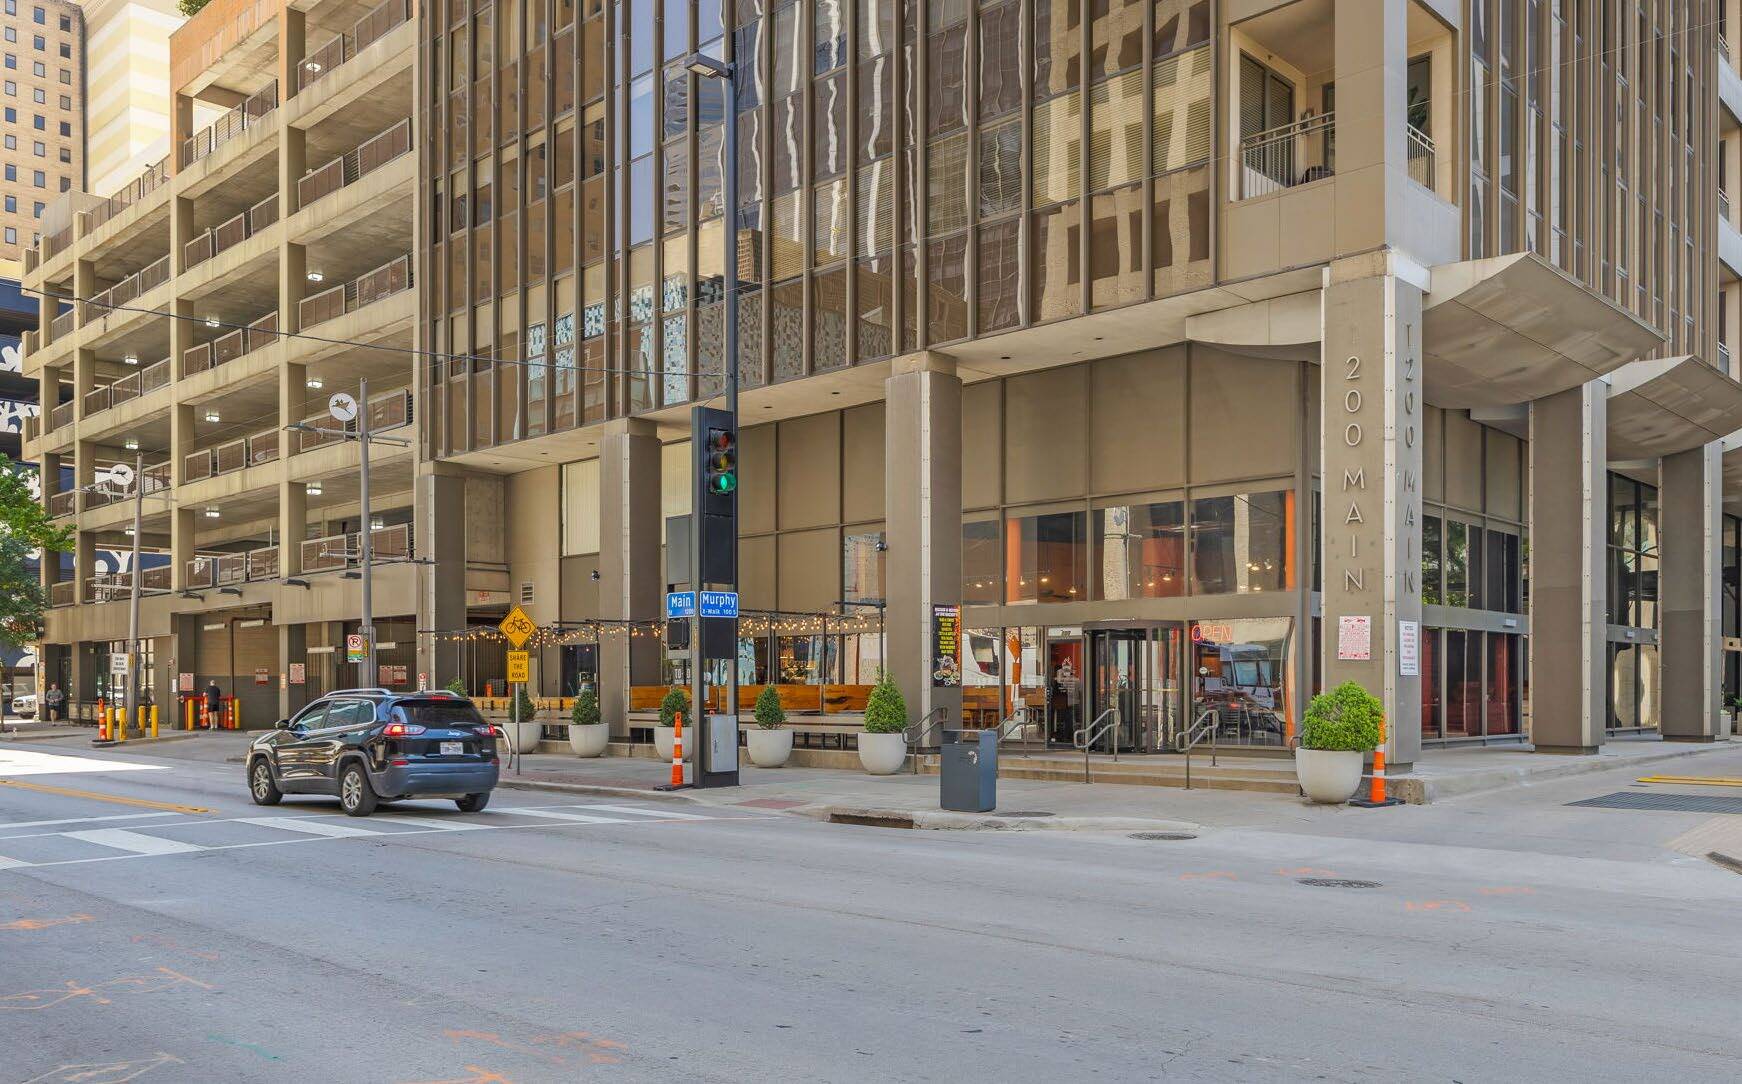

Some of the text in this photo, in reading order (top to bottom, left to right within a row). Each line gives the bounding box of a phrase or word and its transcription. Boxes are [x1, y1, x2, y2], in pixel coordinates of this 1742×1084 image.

[1343, 466, 1365, 592] MAIN
[1403, 469, 1415, 594] MAIN
[671, 595, 691, 608] Main
[702, 593, 736, 608] Murphy
[1191, 624, 1232, 642] OPEN
